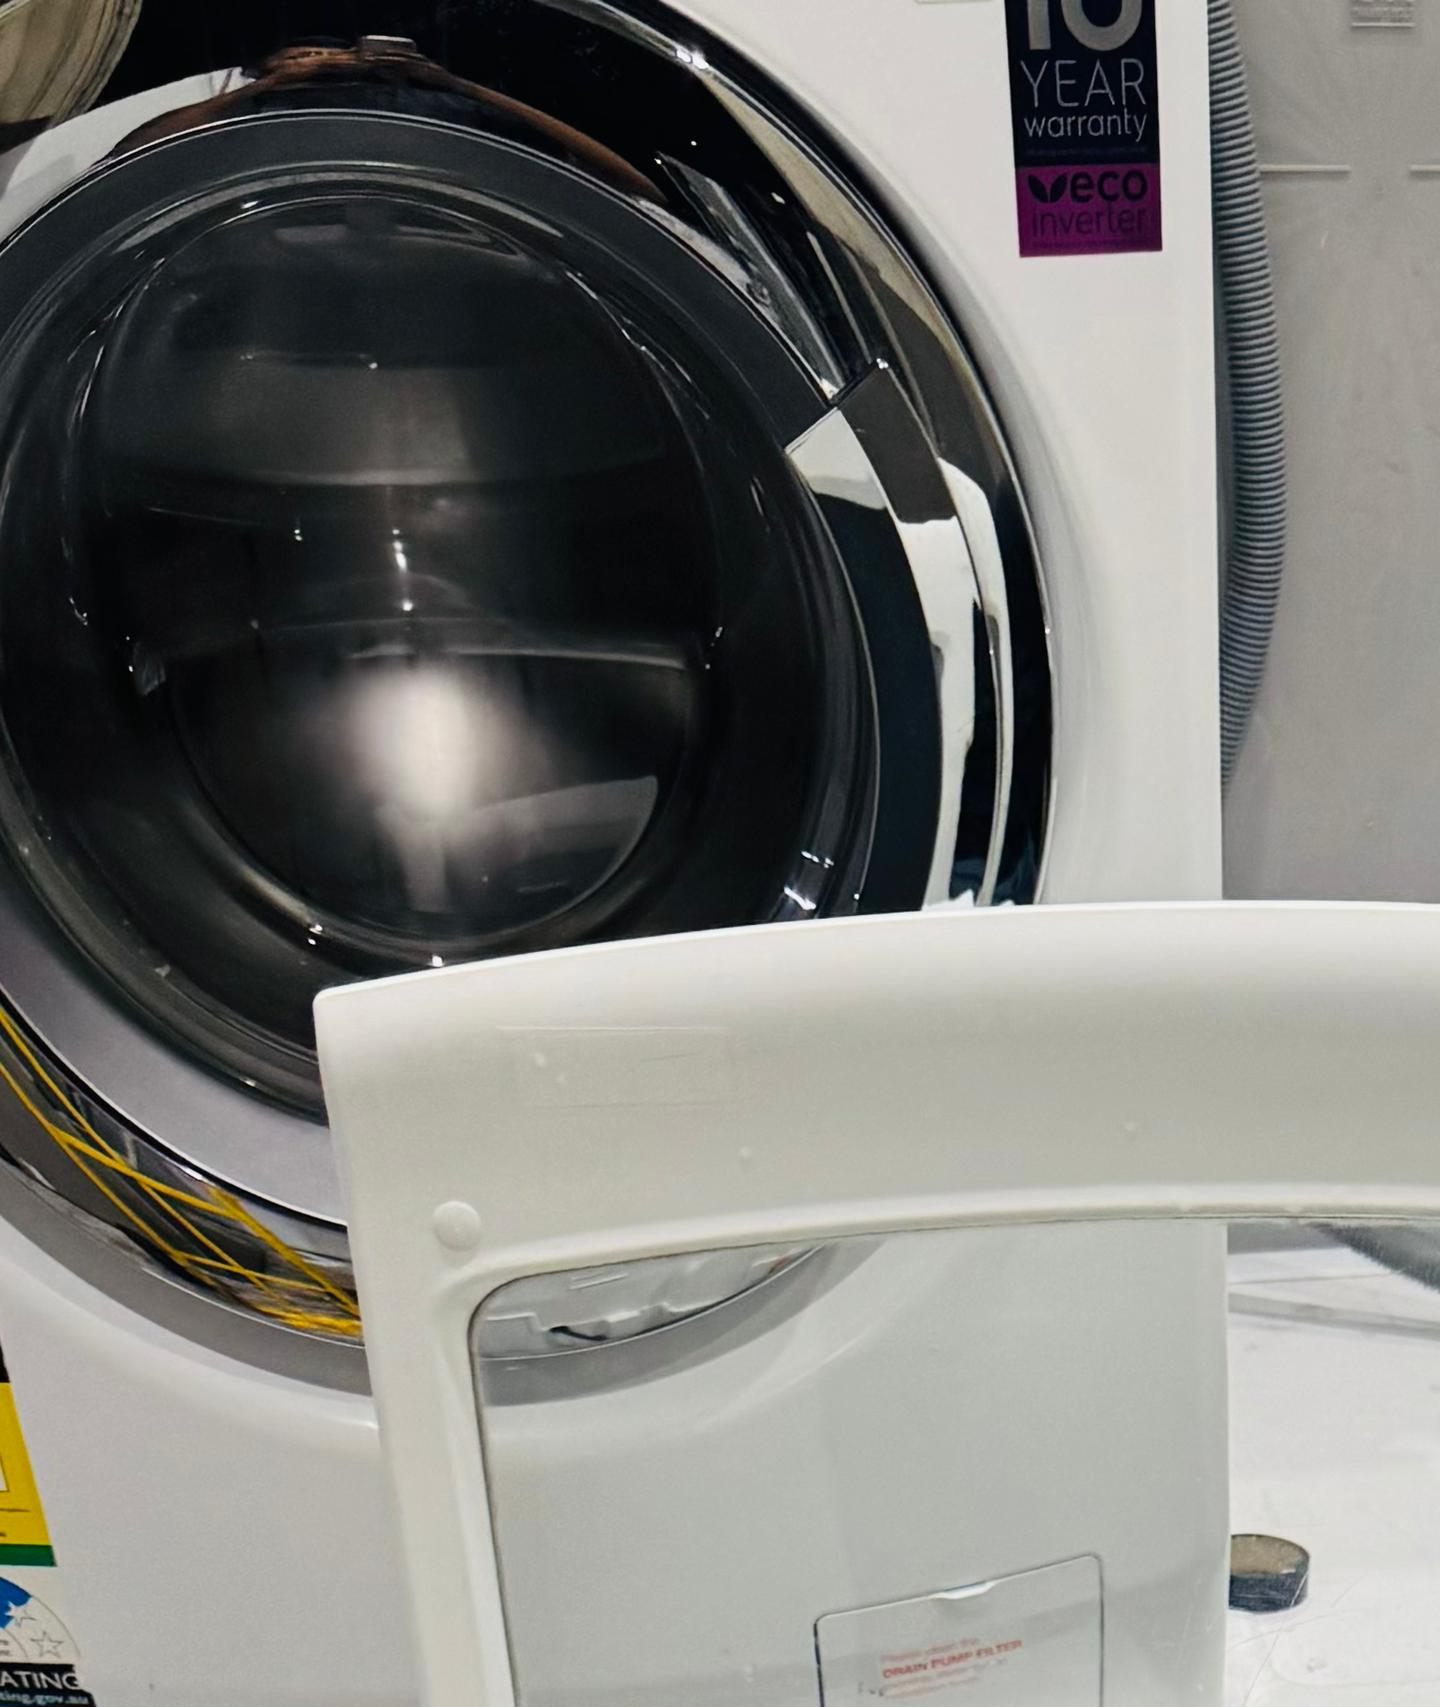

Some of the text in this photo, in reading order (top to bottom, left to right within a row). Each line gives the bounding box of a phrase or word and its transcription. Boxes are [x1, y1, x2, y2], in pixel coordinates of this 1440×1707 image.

[1020, 58, 1147, 108] YEAR
[1024, 108, 1148, 142] warranty
[1069, 169, 1148, 204] eco
[1032, 203, 1147, 238] inverter
